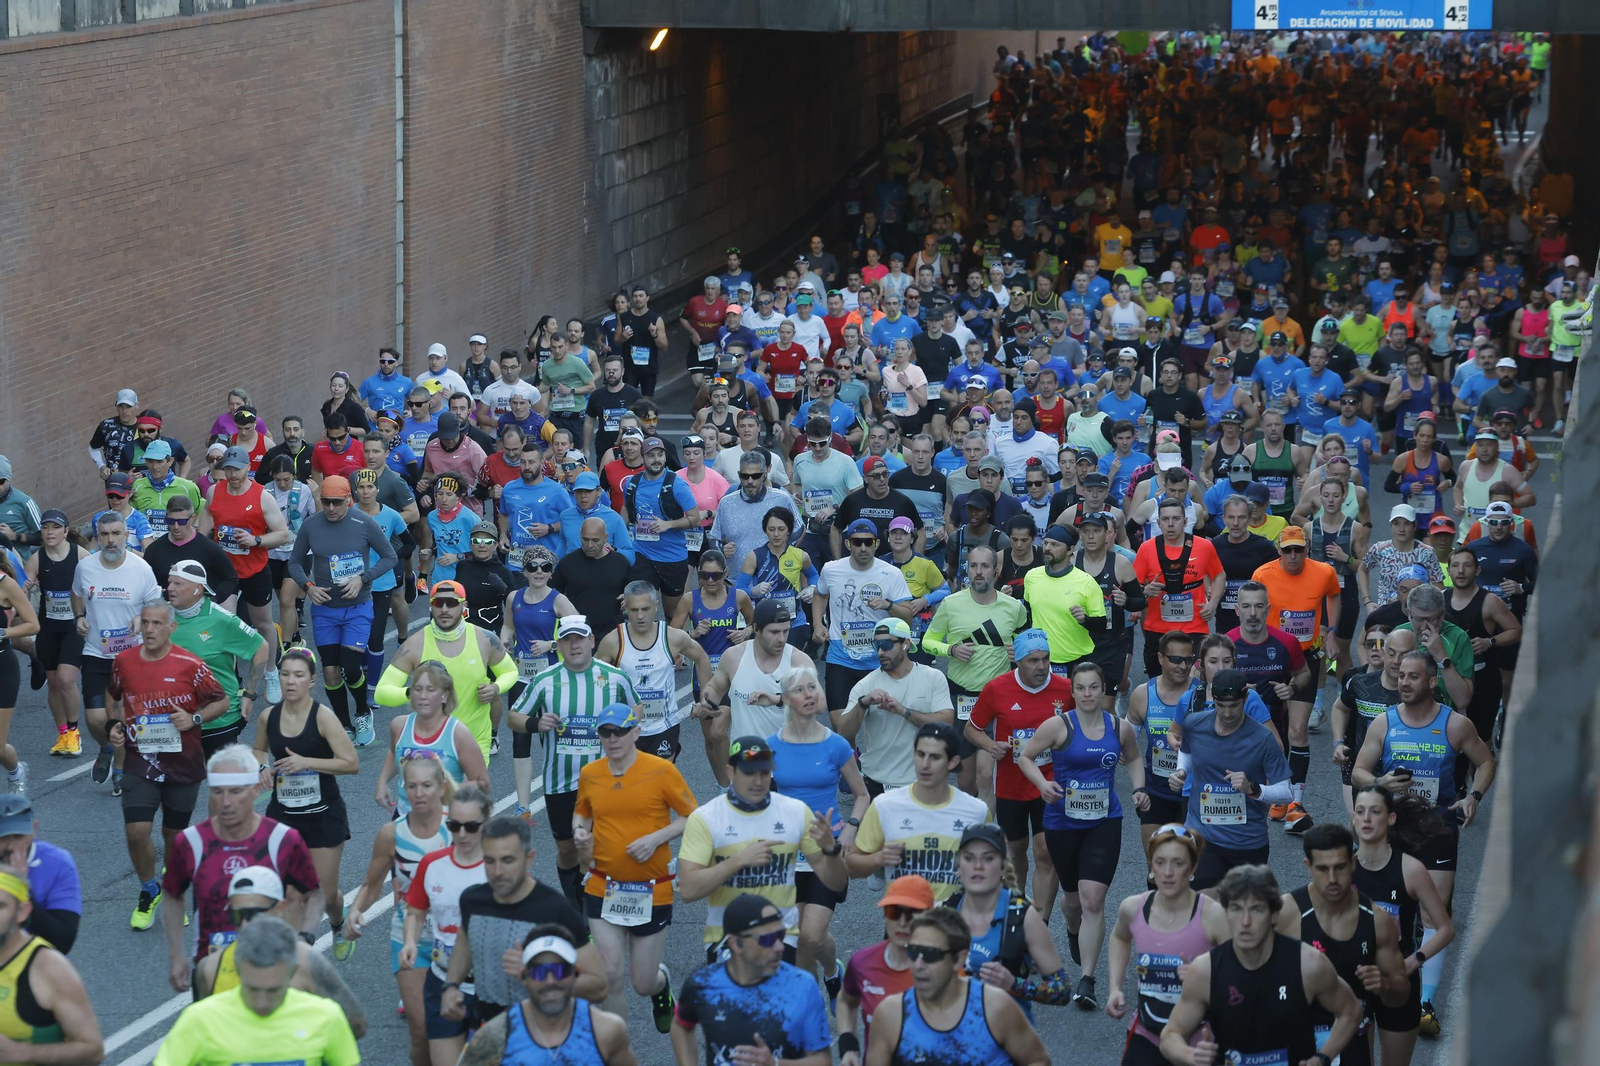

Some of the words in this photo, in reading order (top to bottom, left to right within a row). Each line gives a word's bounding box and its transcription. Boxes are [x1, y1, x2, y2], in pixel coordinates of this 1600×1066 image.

[1379, 9, 1404, 17] SEVILLA
[1290, 16, 1357, 29] DELEGACIÓN
[1359, 17, 1374, 28] DE
[1376, 17, 1434, 29] MOVILIDAD
[151, 523, 169, 532] ACINE
[1171, 594, 1189, 602] ZURICH
[52, 605, 71, 613] ZAIRA
[1170, 608, 1185, 616] TOM
[1292, 611, 1312, 619] ZURICH
[1285, 626, 1310, 637] RAINER
[109, 644, 132, 655] LOGAN
[525, 668, 538, 676] AMY
[143, 692, 194, 709] MARATÓN
[571, 717, 598, 725] ZURICH
[138, 736, 174, 747] BOCANEGRA
[557, 737, 572, 746] JAVI
[573, 737, 602, 747] RUNNER
[1418, 742, 1447, 753] 42.195
[1390, 752, 1421, 762] Carlos
[1412, 768, 1434, 776] URICH
[1081, 781, 1105, 789] ZURICH
[280, 787, 316, 798] VIRGINIA
[1070, 799, 1104, 810] KIRSTEN
[1214, 797, 1231, 805] 10319
[1204, 804, 1242, 815] RUMBITA
[924, 836, 939, 850] 59
[621, 883, 648, 892] ZURICH
[609, 903, 645, 916] ADRIAN
[972, 942, 992, 959] TRAIL
[1152, 957, 1184, 967] ZURICH
[1245, 1053, 1280, 1065] ZURICH
